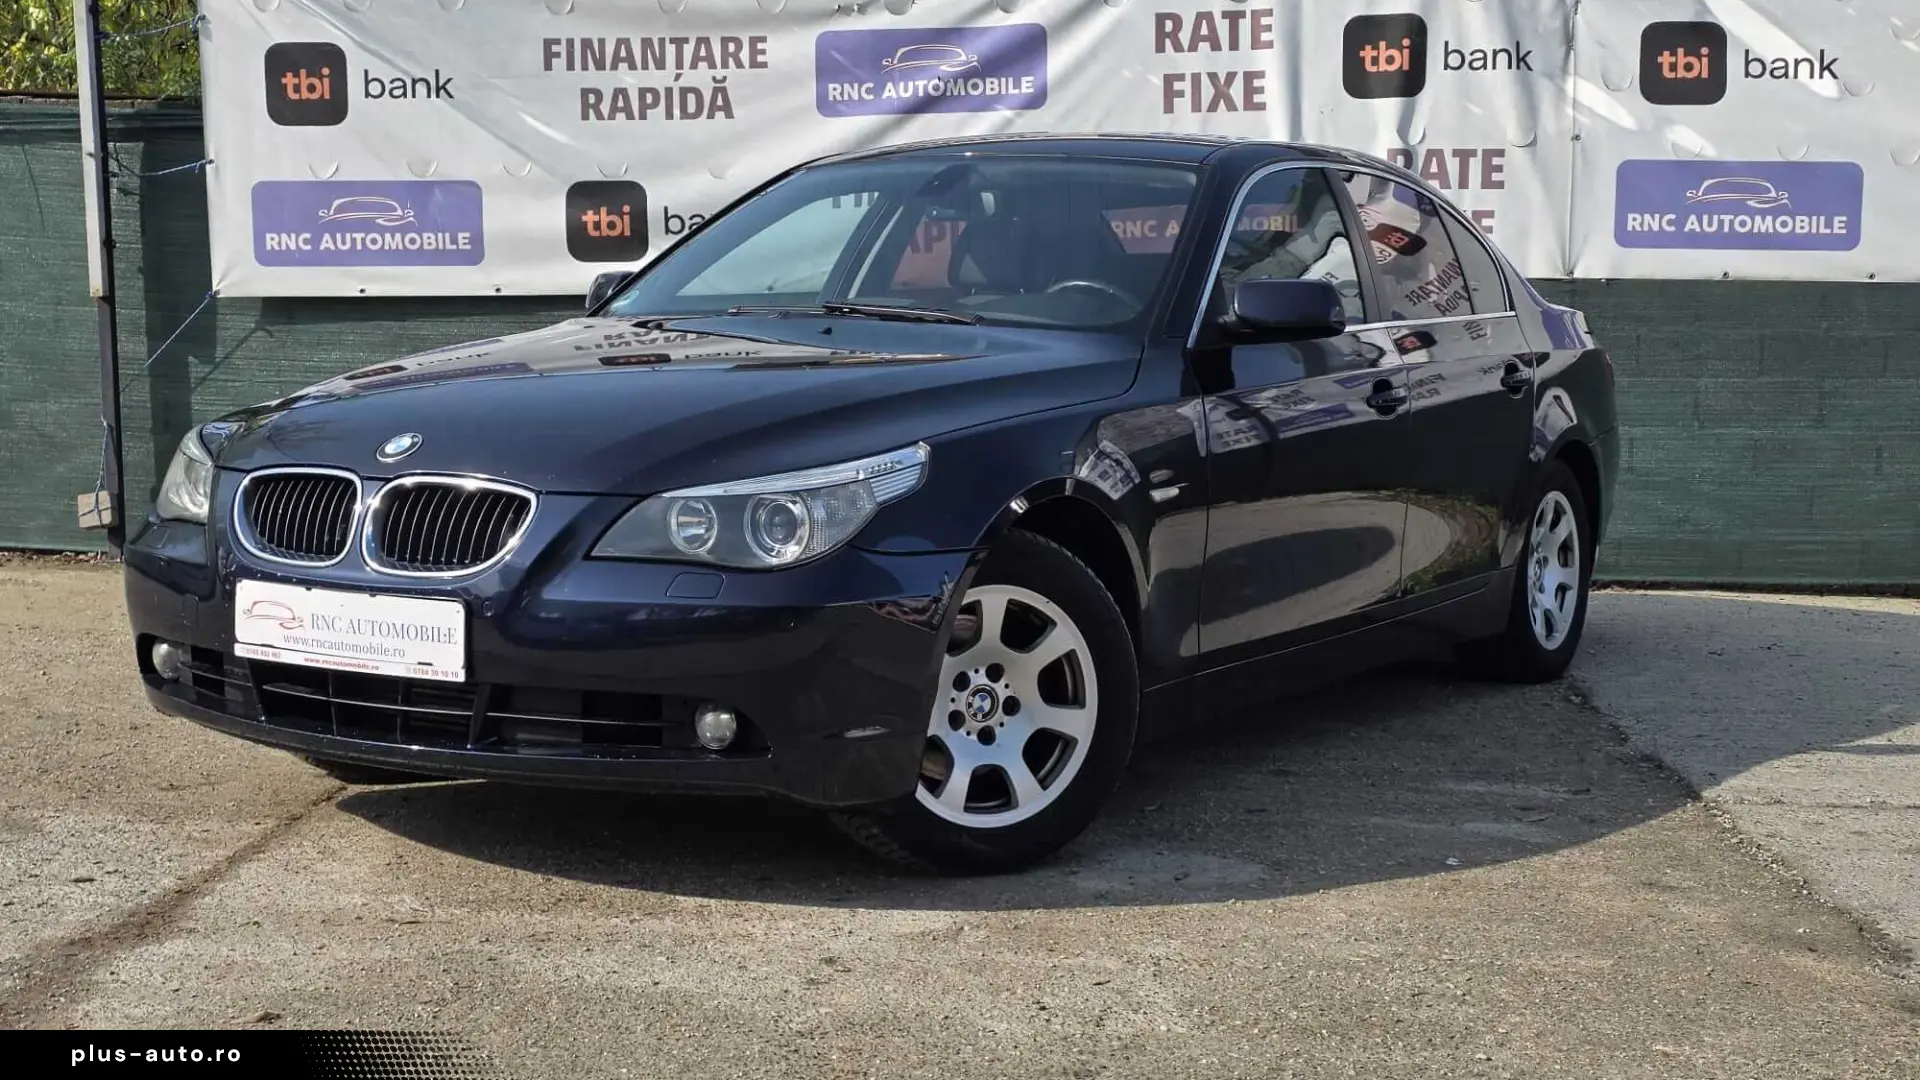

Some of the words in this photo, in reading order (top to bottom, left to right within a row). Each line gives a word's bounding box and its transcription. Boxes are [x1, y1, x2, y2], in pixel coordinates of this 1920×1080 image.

[1154, 8, 1275, 54] RATE
[543, 35, 769, 83] FINANȚARE
[1359, 38, 1412, 73] tbi
[1443, 41, 1534, 72] bank
[1657, 47, 1710, 79] tbi
[1744, 49, 1839, 80] bank
[281, 67, 331, 100] tbi
[363, 69, 455, 100] bank
[579, 75, 735, 121] RAPIDĂ
[827, 82, 875, 102] RNC
[882, 76, 1035, 100] AUTOMOBILE
[1162, 70, 1267, 115] FIXE
[581, 204, 632, 238] tbi
[663, 206, 716, 236] ba
[1626, 213, 1677, 233] RNC
[1684, 214, 1847, 235] AUTOMOBILE
[265, 233, 312, 251] RNC
[319, 232, 472, 251] AUTOMOBILE
[310, 613, 342, 634] RNC
[346, 618, 459, 646] AUTOMOBILE
[283, 634, 406, 659] www.rncautomobile.ro
